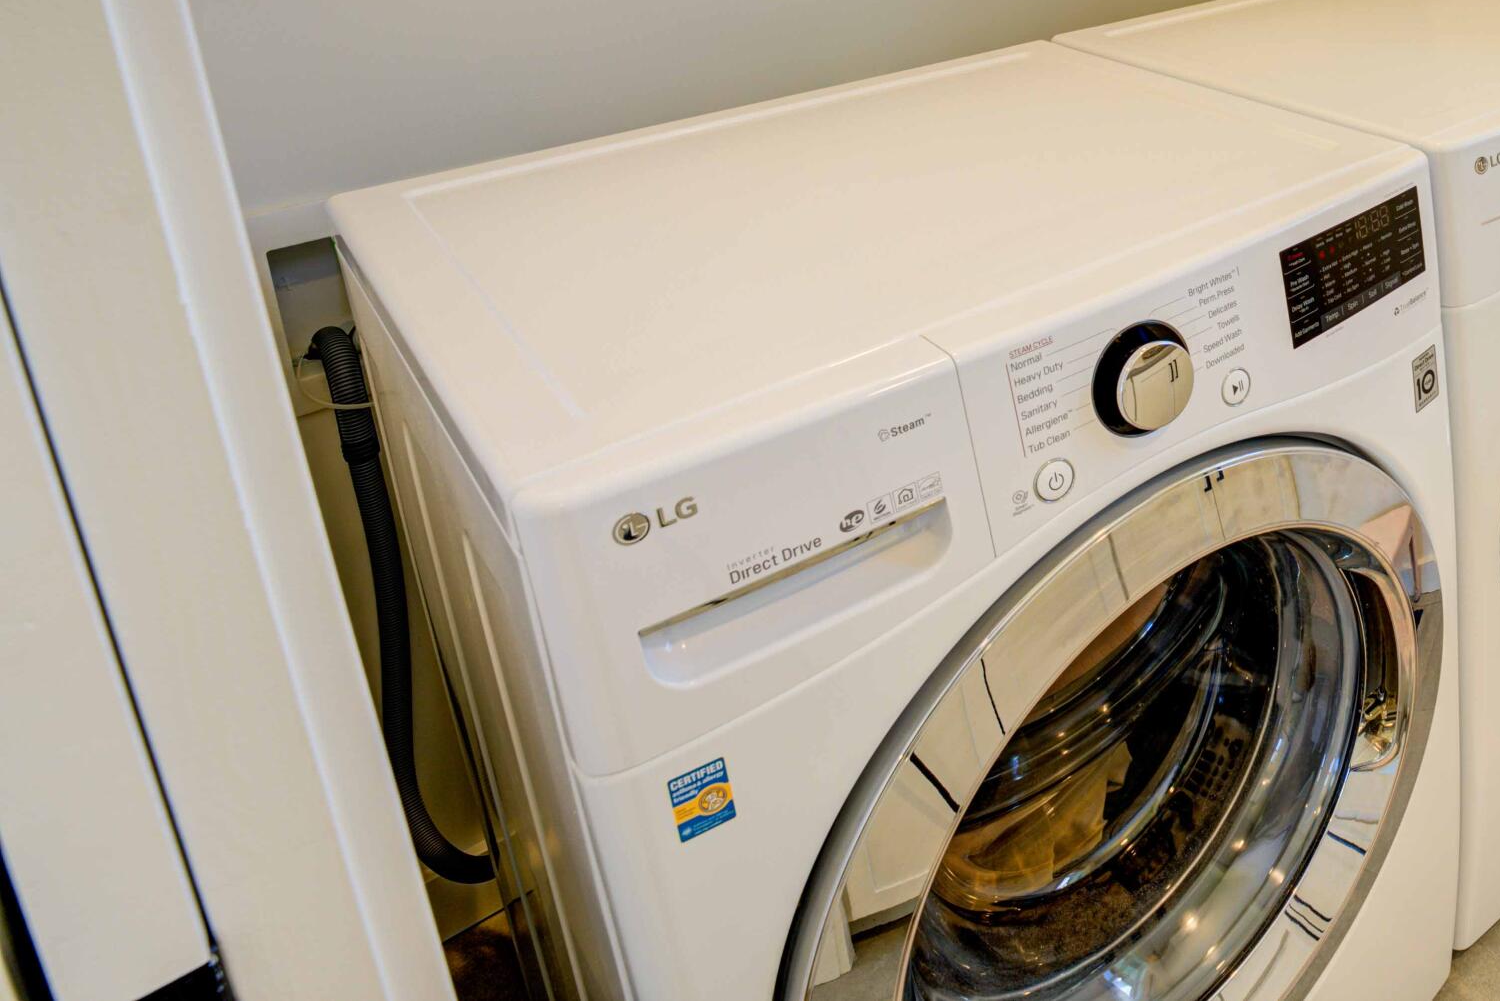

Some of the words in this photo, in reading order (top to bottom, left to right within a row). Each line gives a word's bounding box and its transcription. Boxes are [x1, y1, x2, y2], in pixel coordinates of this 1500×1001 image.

[1188, 282, 1208, 297] Bright
[1217, 286, 1235, 298] Press
[1208, 300, 1238, 319] Delicates
[1217, 314, 1240, 329] Towels
[1009, 342, 1032, 359] STEAM
[1033, 335, 1054, 349] CYCLE
[1203, 338, 1224, 353] Speed
[1224, 328, 1242, 343] Wash
[1010, 352, 1042, 372] Normal
[1205, 344, 1245, 369] Downloaded
[1014, 370, 1042, 388] Heavy
[1043, 361, 1064, 376] Duty
[1416, 369, 1435, 400] 10
[1017, 384, 1054, 404] Bedding
[1020, 399, 1058, 421] Sanitary
[1028, 440, 1046, 454] Tub
[1046, 430, 1071, 446] Clean
[656, 496, 698, 528] LG
[729, 554, 778, 585] Direct
[781, 536, 822, 562] Drive
[670, 760, 724, 792] CERTIFIED
